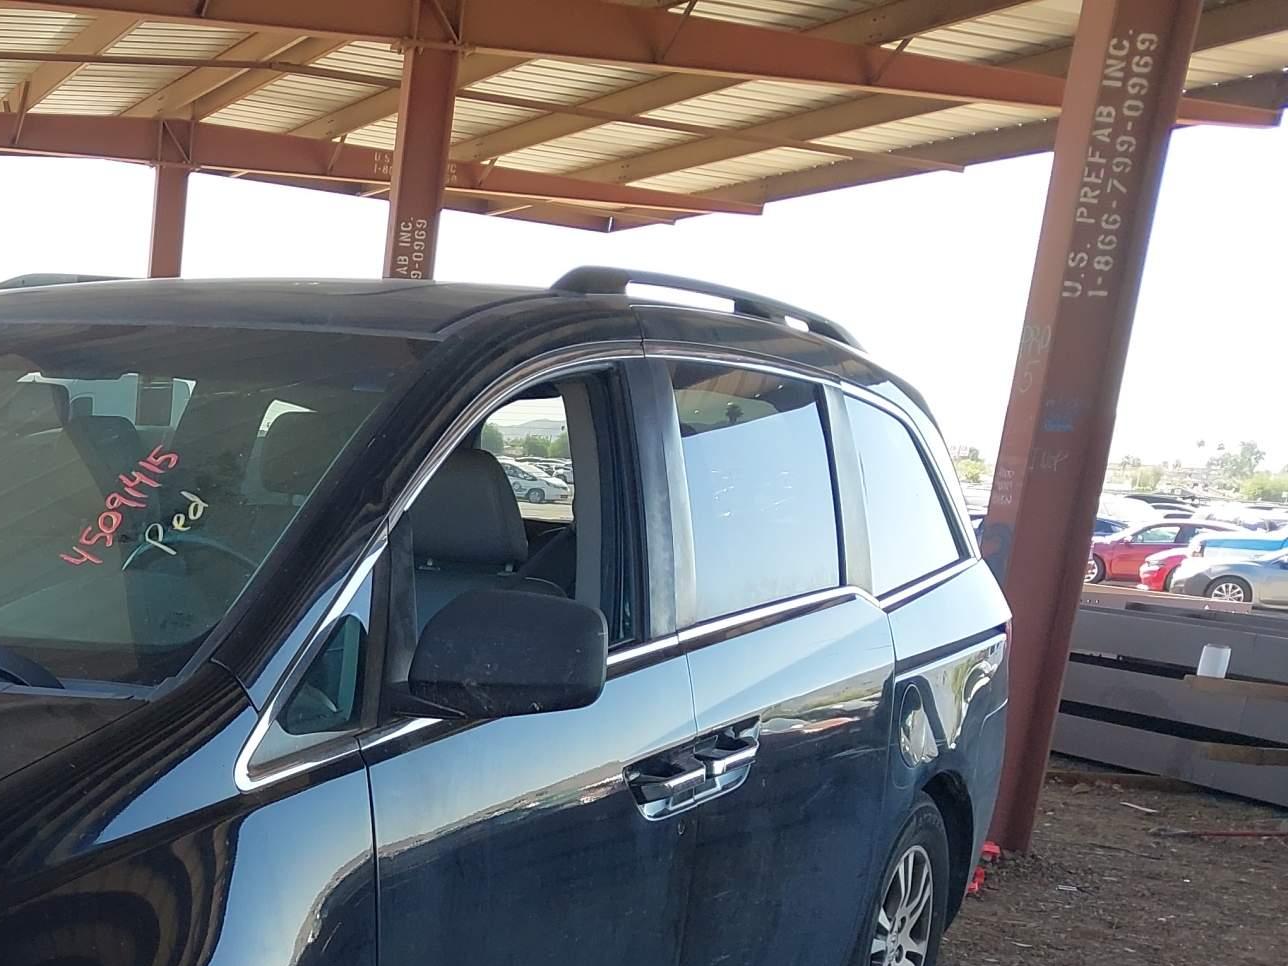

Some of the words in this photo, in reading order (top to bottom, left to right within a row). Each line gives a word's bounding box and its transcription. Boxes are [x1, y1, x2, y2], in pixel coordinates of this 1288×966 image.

[1102, 29, 1134, 88] INC.
[1076, 105, 1116, 223] PREFAB
[1088, 32, 1158, 298] 1-866-799-0969
[1062, 243, 1091, 298] U.S.
[59, 444, 180, 567] 45091415
